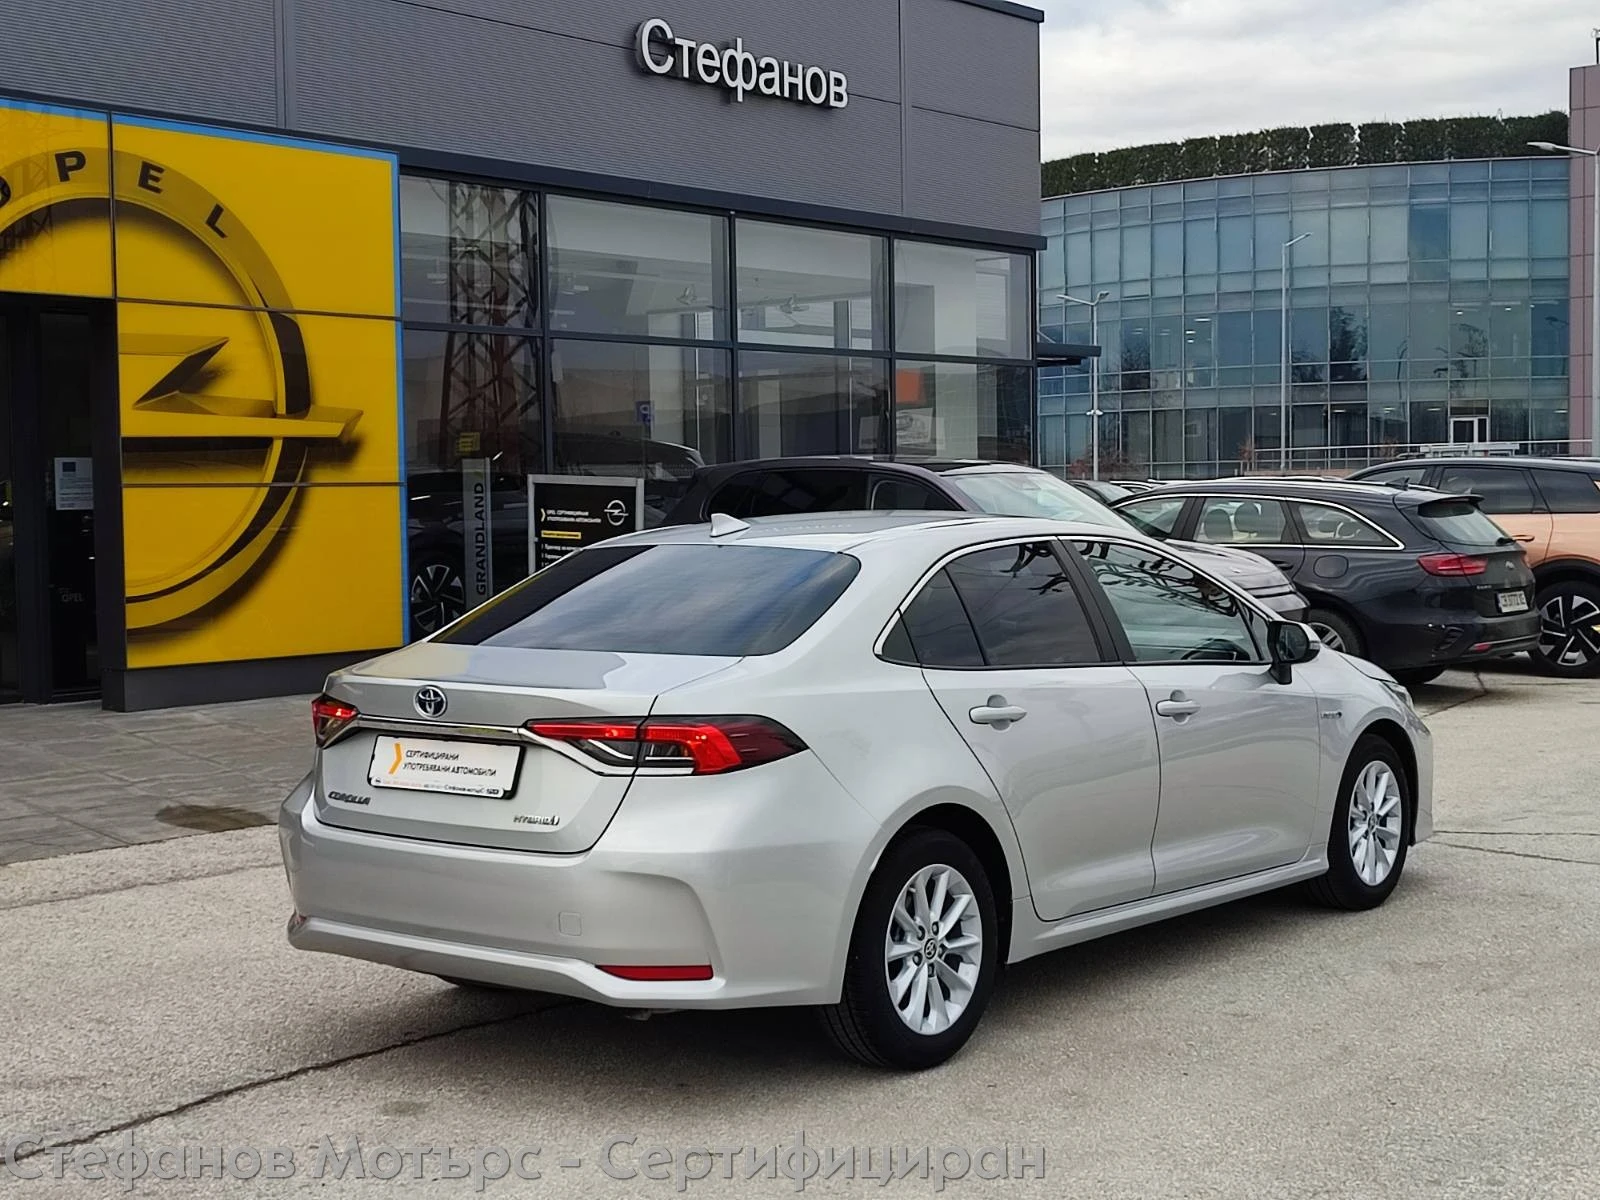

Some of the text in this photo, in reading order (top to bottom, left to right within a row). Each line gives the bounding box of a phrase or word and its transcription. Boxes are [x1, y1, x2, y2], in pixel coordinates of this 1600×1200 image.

[640, 18, 849, 109] Стефанов
[473, 482, 487, 596] GRANDLAND
[405, 749, 460, 761] СЕРТИФИЦИРАНИ
[451, 766, 497, 777] АВТОМОБИЛИ
